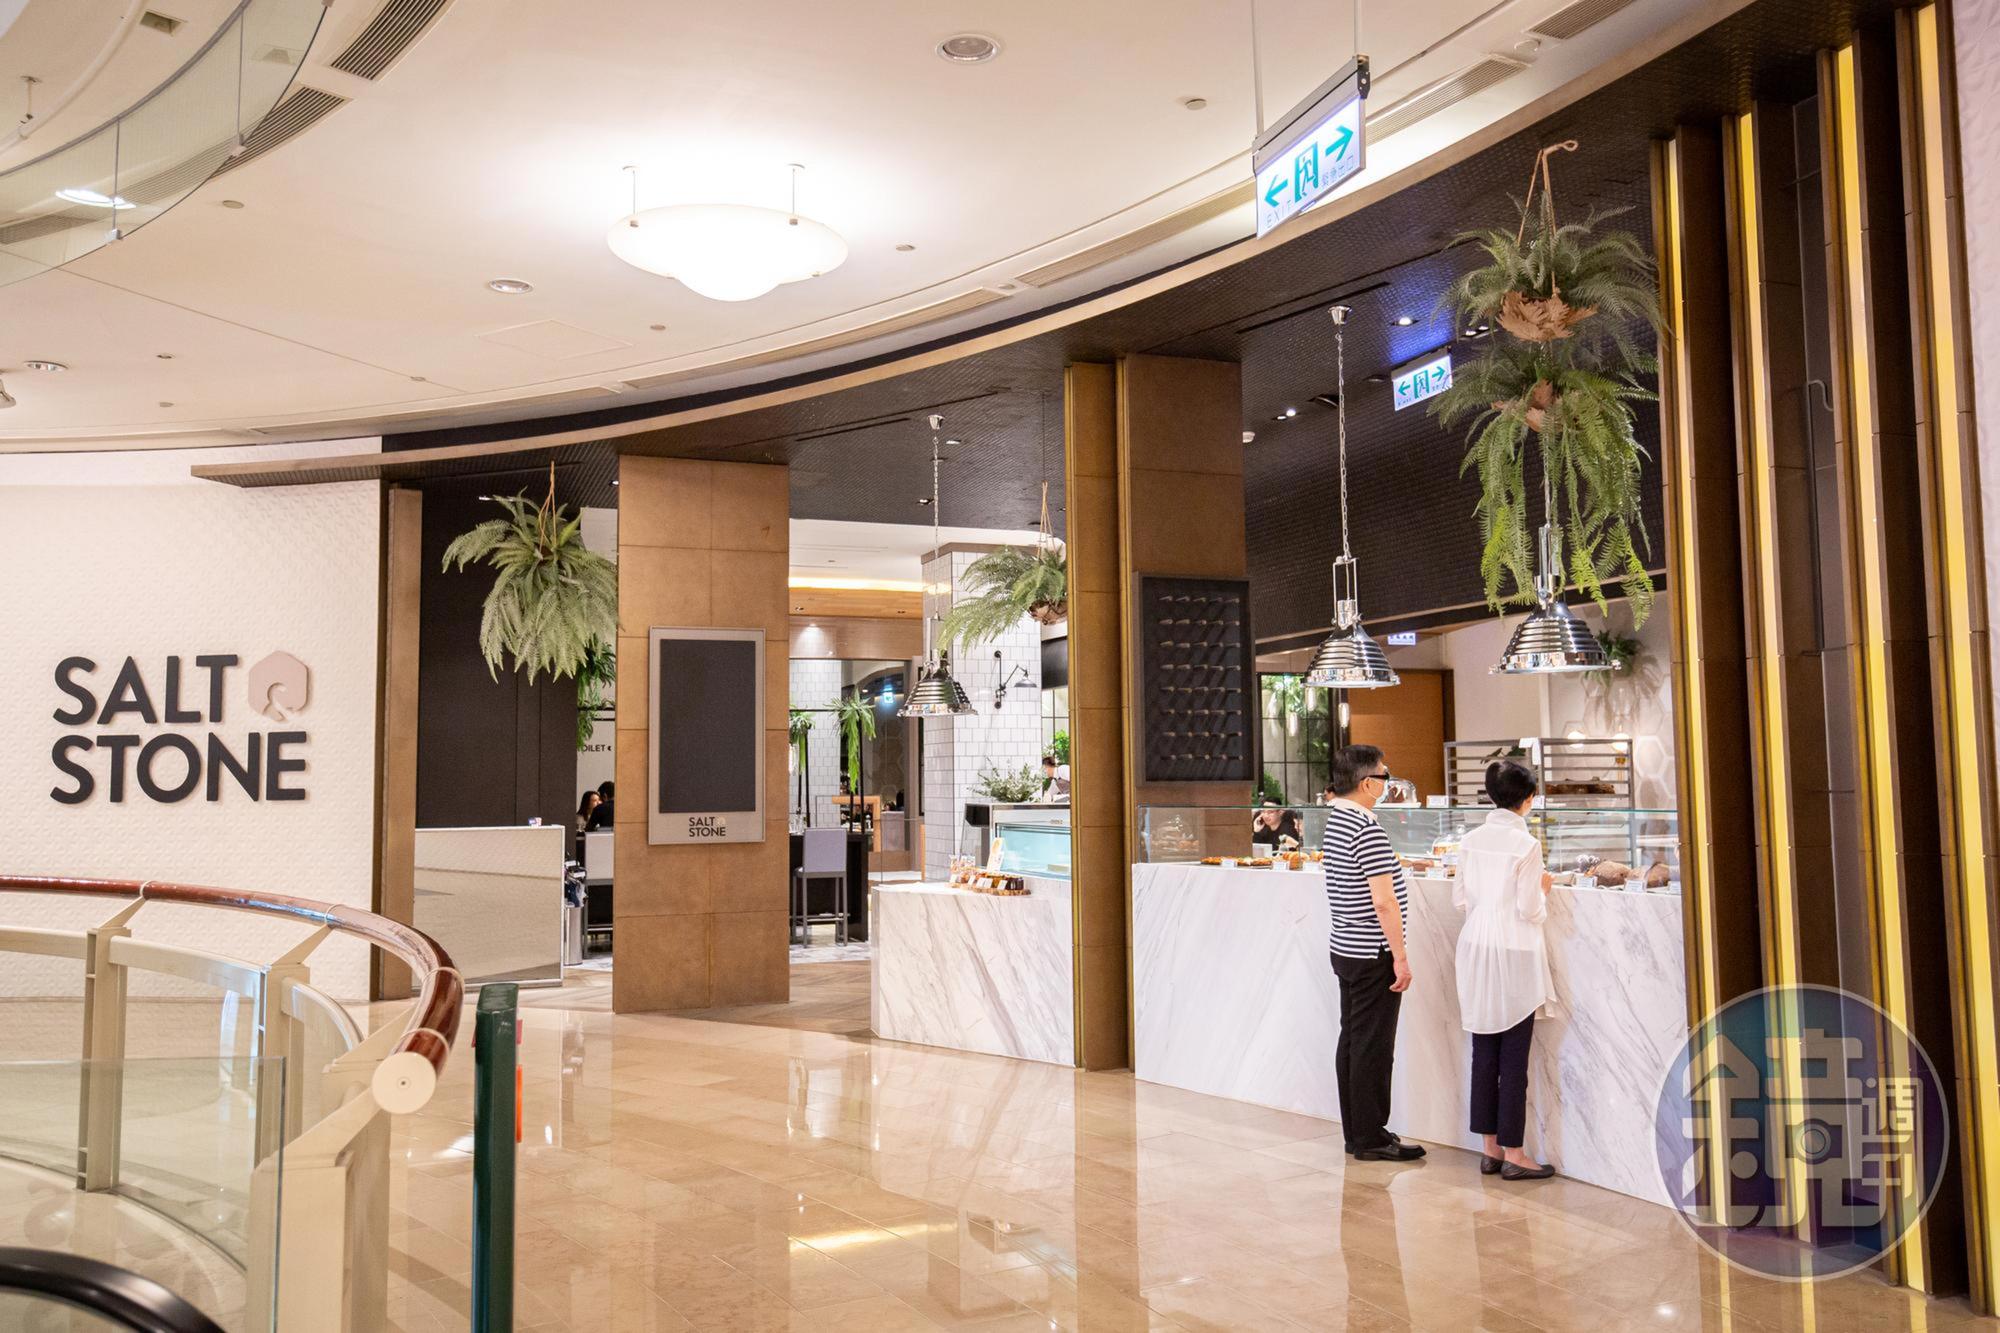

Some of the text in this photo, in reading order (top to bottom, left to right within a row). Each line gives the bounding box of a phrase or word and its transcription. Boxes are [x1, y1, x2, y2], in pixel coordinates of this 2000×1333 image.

[1266, 198, 1293, 229] EXIT
[53, 655, 238, 725] SALT
[578, 744, 606, 752] OILET
[50, 731, 307, 804] STONE
[689, 816, 715, 827] SALT
[689, 826, 726, 837] STONE
